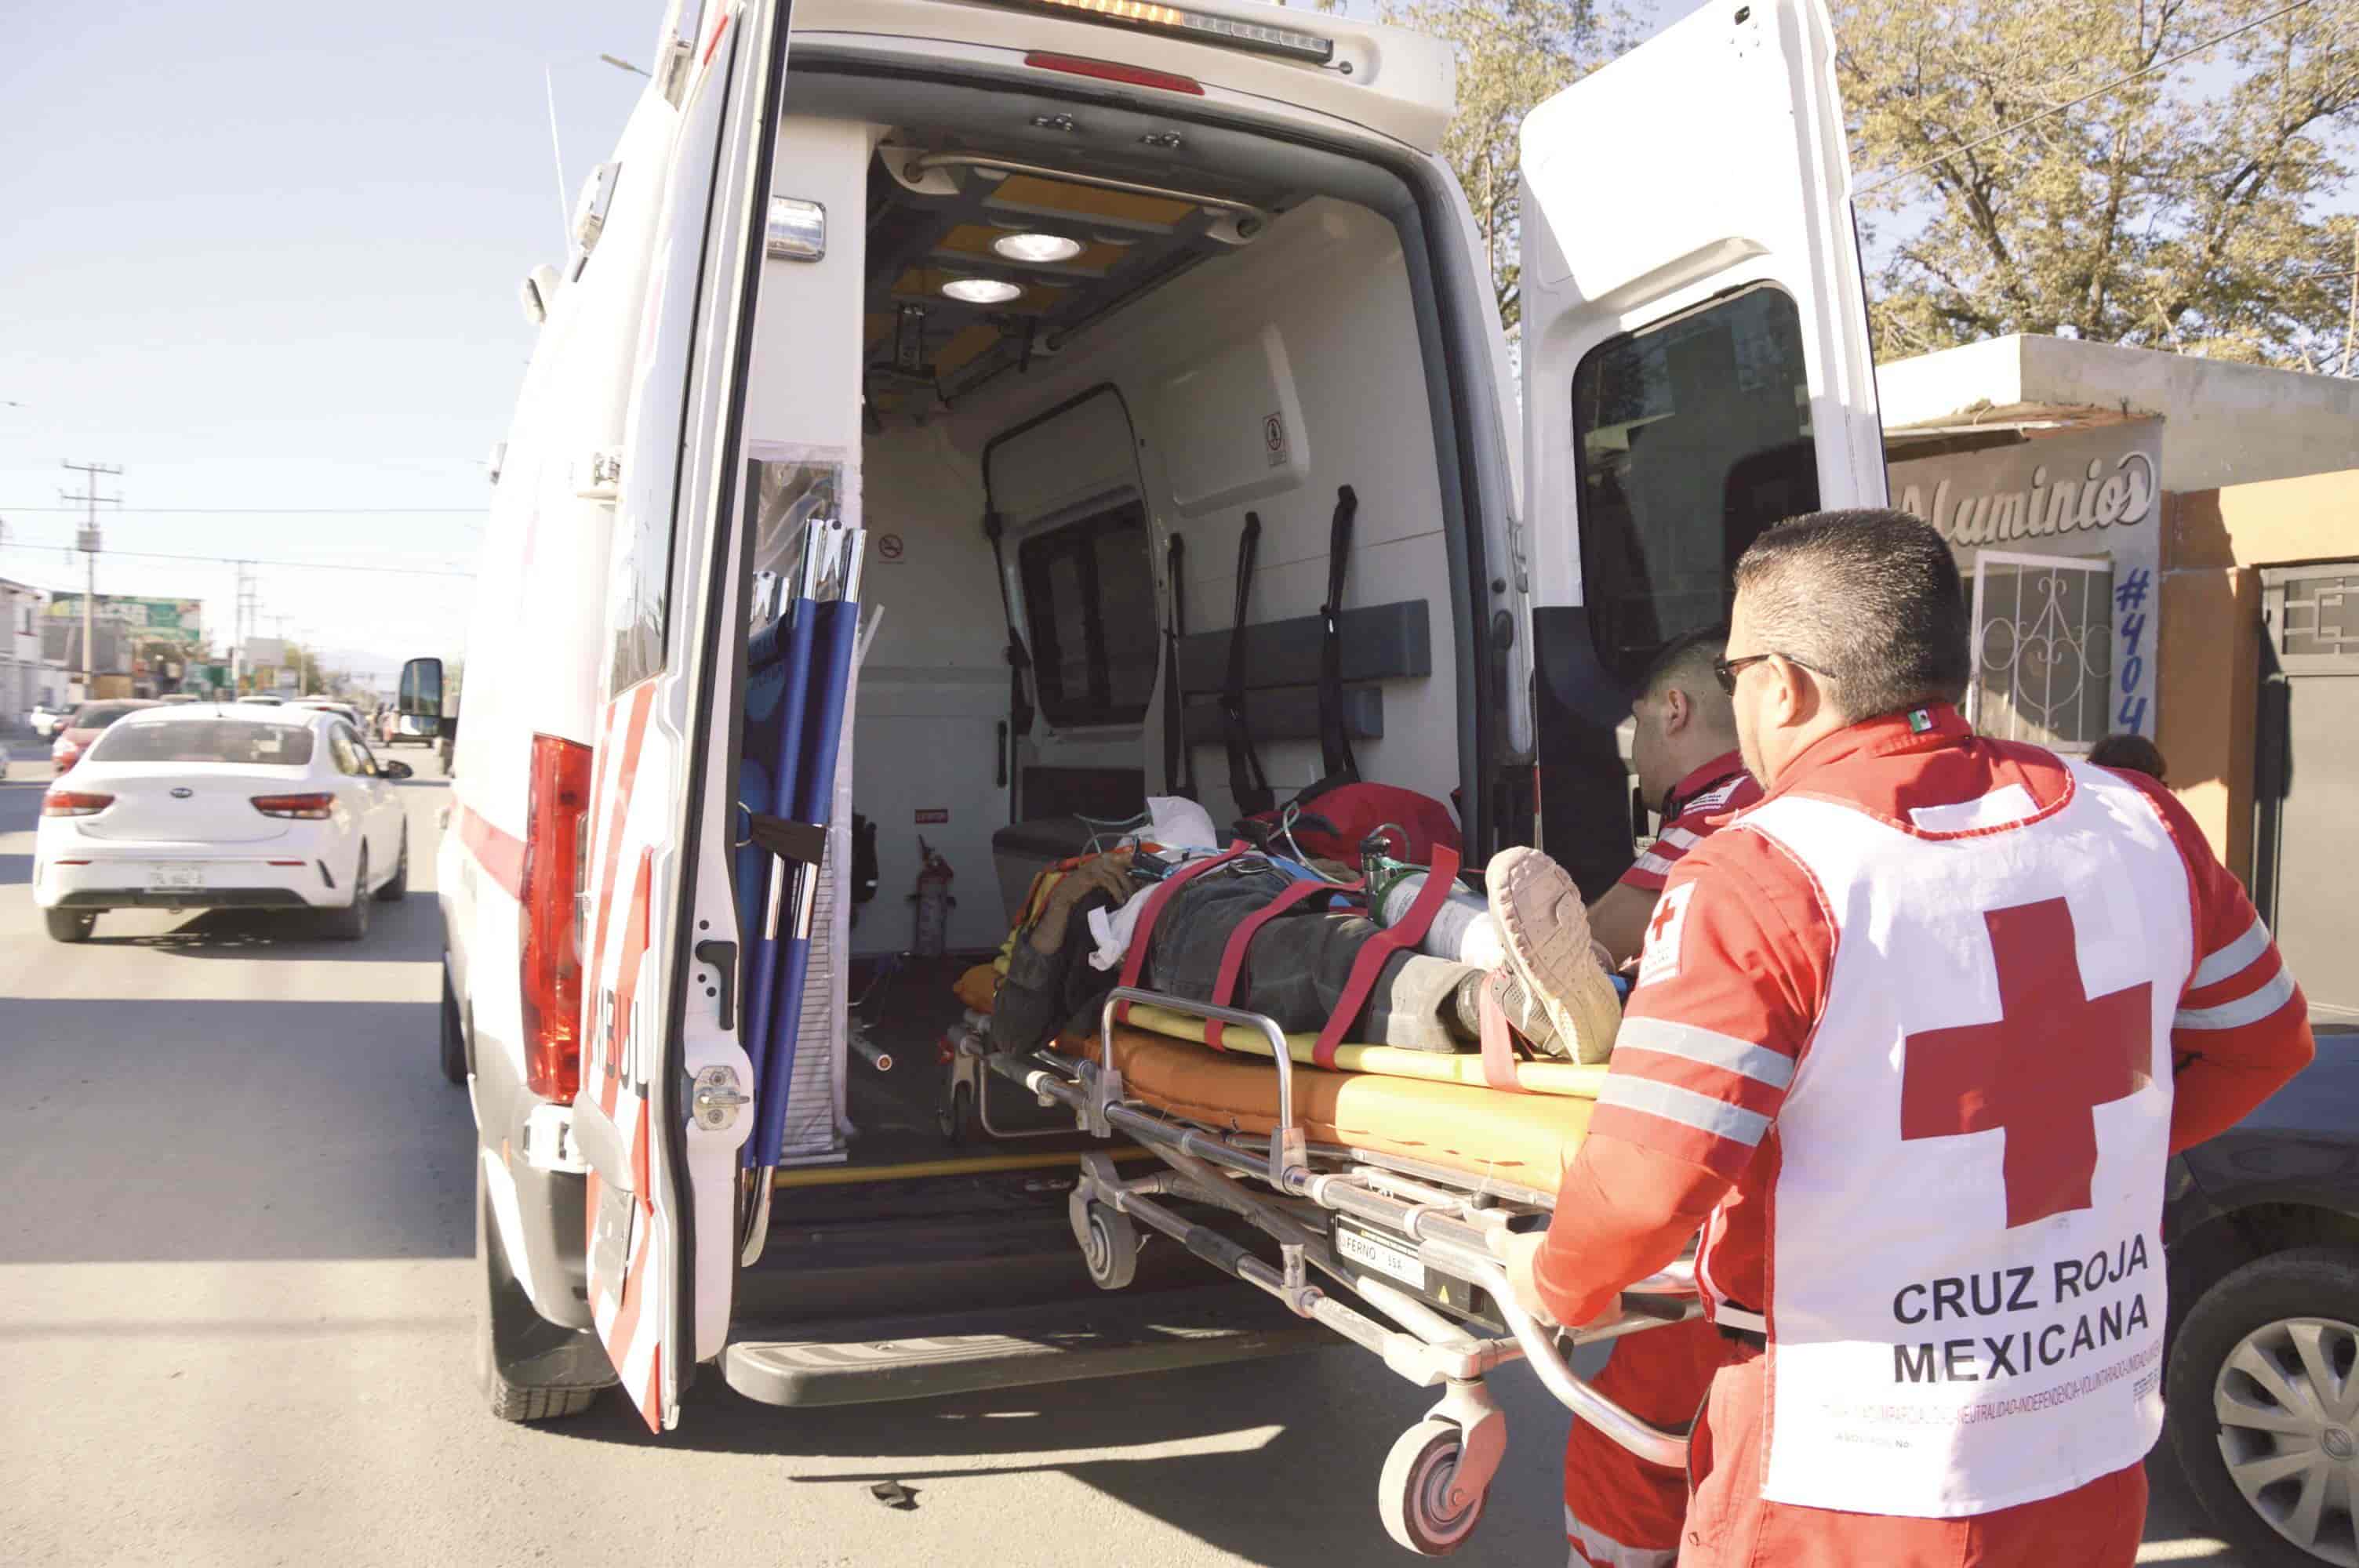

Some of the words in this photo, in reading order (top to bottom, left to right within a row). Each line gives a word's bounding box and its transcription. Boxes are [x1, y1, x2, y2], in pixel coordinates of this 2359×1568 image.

[2114, 566, 2150, 735] #404
[1347, 1237, 1376, 1260] FERNO
[1892, 1266, 2038, 1325] CRUZ
[2054, 1232, 2149, 1303] ROJA
[1894, 1293, 2150, 1384] MEXICANA
